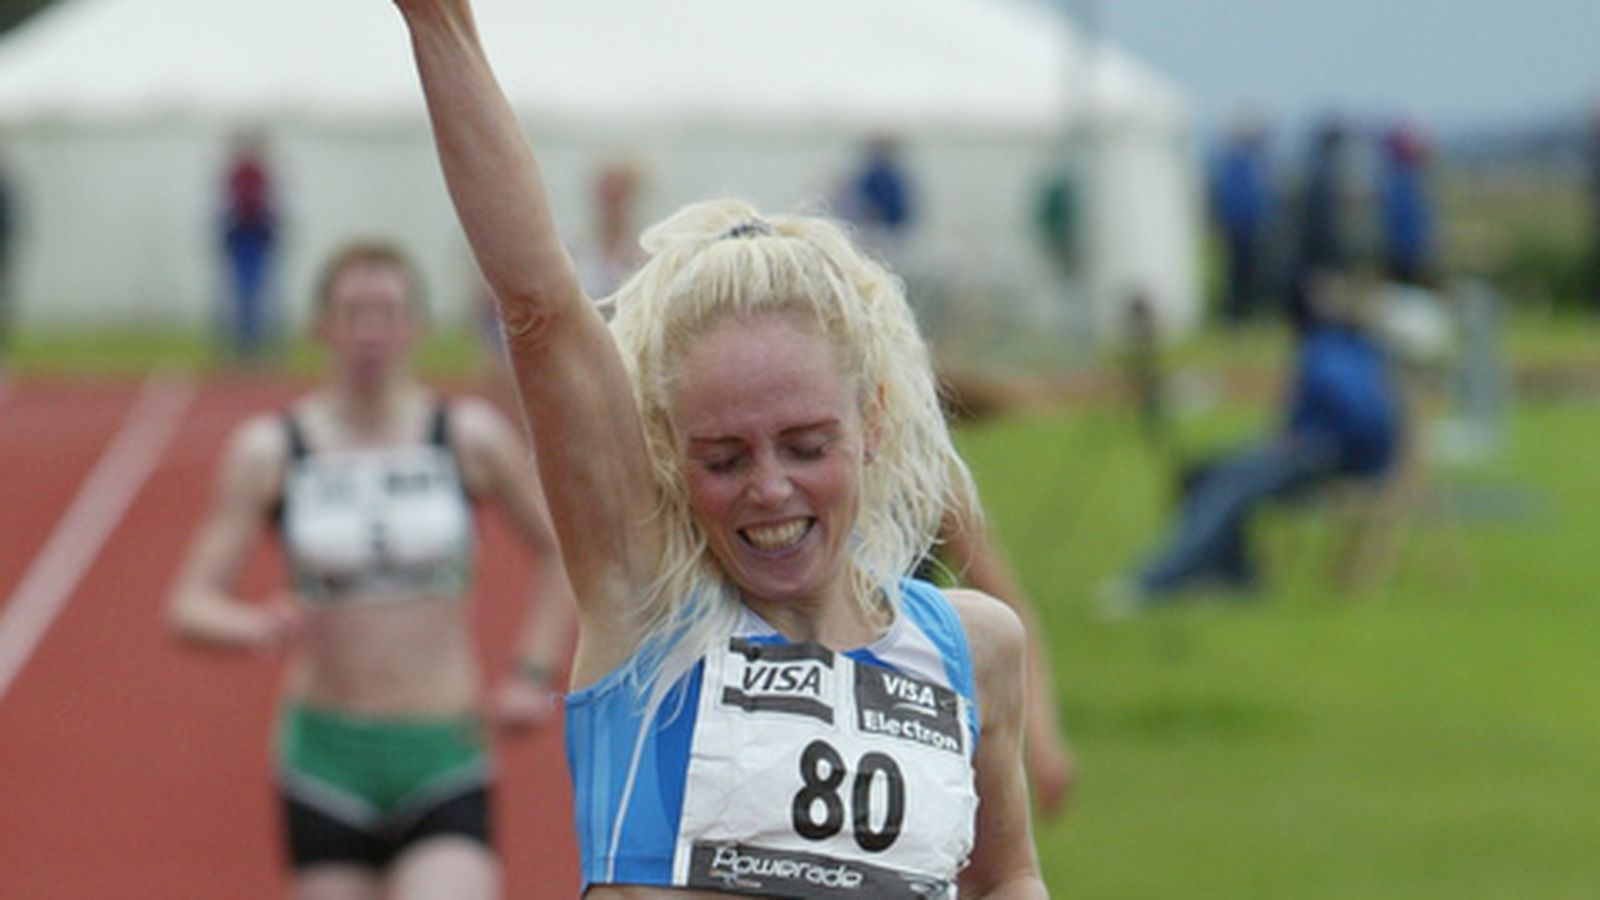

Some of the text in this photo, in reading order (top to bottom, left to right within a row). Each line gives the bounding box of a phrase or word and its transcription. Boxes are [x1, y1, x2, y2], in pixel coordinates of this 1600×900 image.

[743, 665, 821, 696] VISA
[882, 673, 935, 708] VISA
[863, 709, 959, 750] Electron
[792, 740, 906, 853] 80
[712, 847, 864, 888] Powerade
